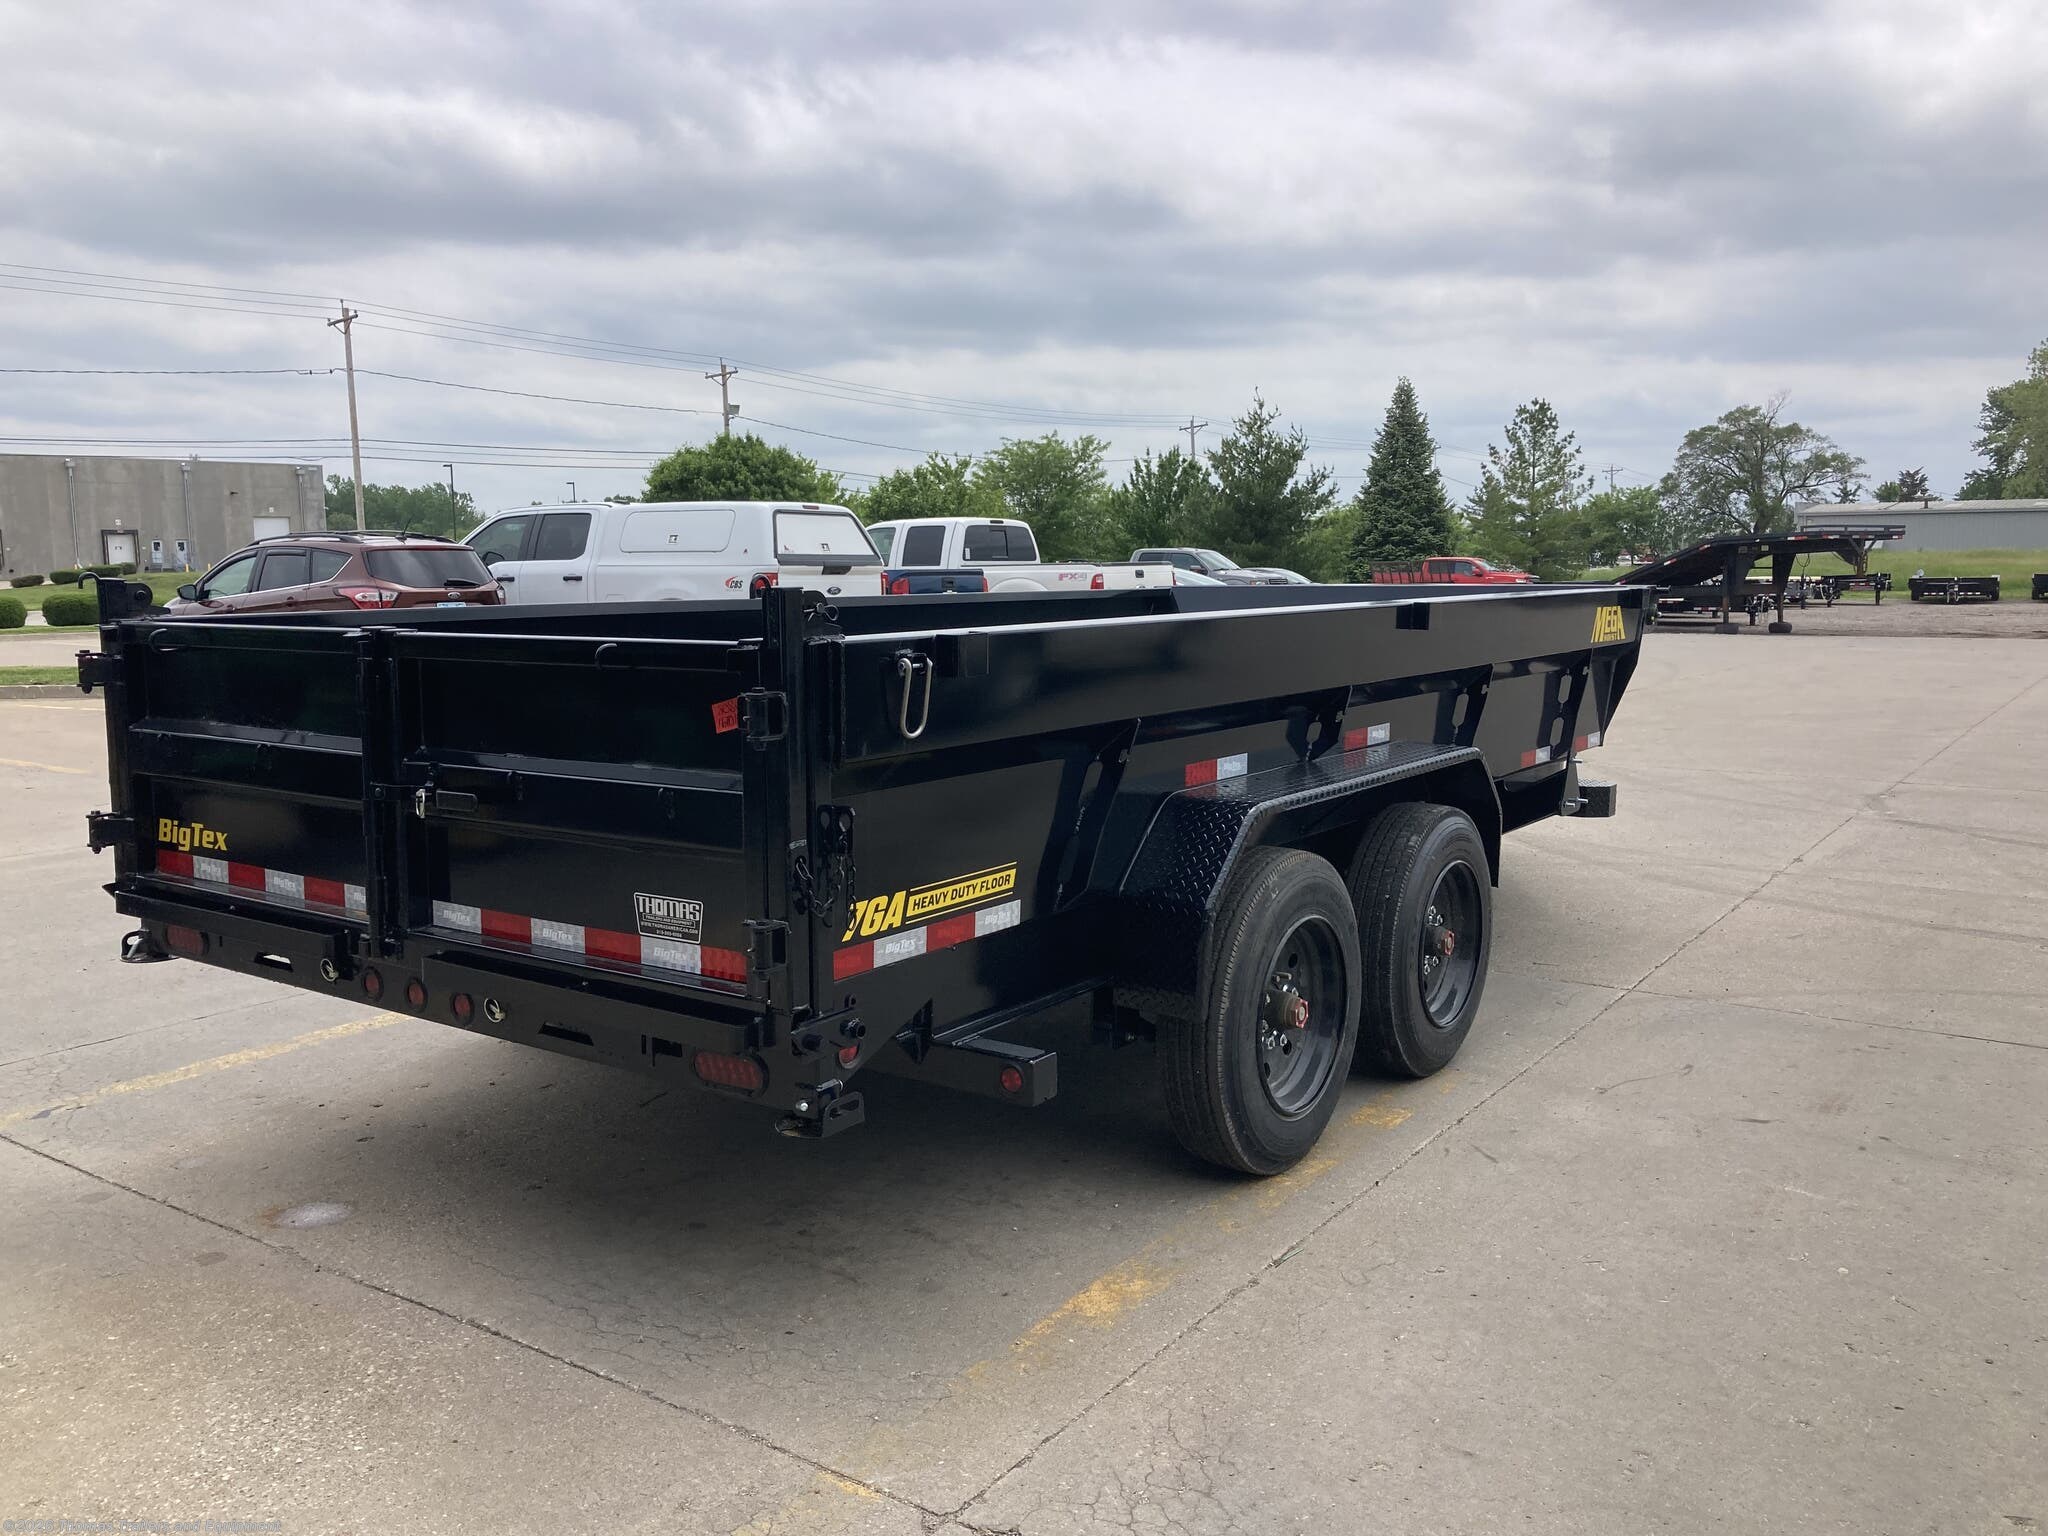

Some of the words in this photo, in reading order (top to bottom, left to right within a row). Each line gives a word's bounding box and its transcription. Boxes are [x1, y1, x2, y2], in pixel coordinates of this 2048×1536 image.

[1059, 573, 1087, 581] FX4
[1591, 606, 1625, 643] MEGA
[158, 818, 228, 851] BigTex
[273, 877, 296, 890] BigTex
[912, 891, 950, 911] HEAVY
[951, 883, 978, 900] DUTY
[979, 873, 1011, 893] FLOOR
[636, 895, 700, 921] THOMAS
[443, 909, 471, 925] BigTex
[542, 927, 574, 945] BigTex
[885, 937, 916, 953] BigTex
[654, 947, 688, 963] BigTex
